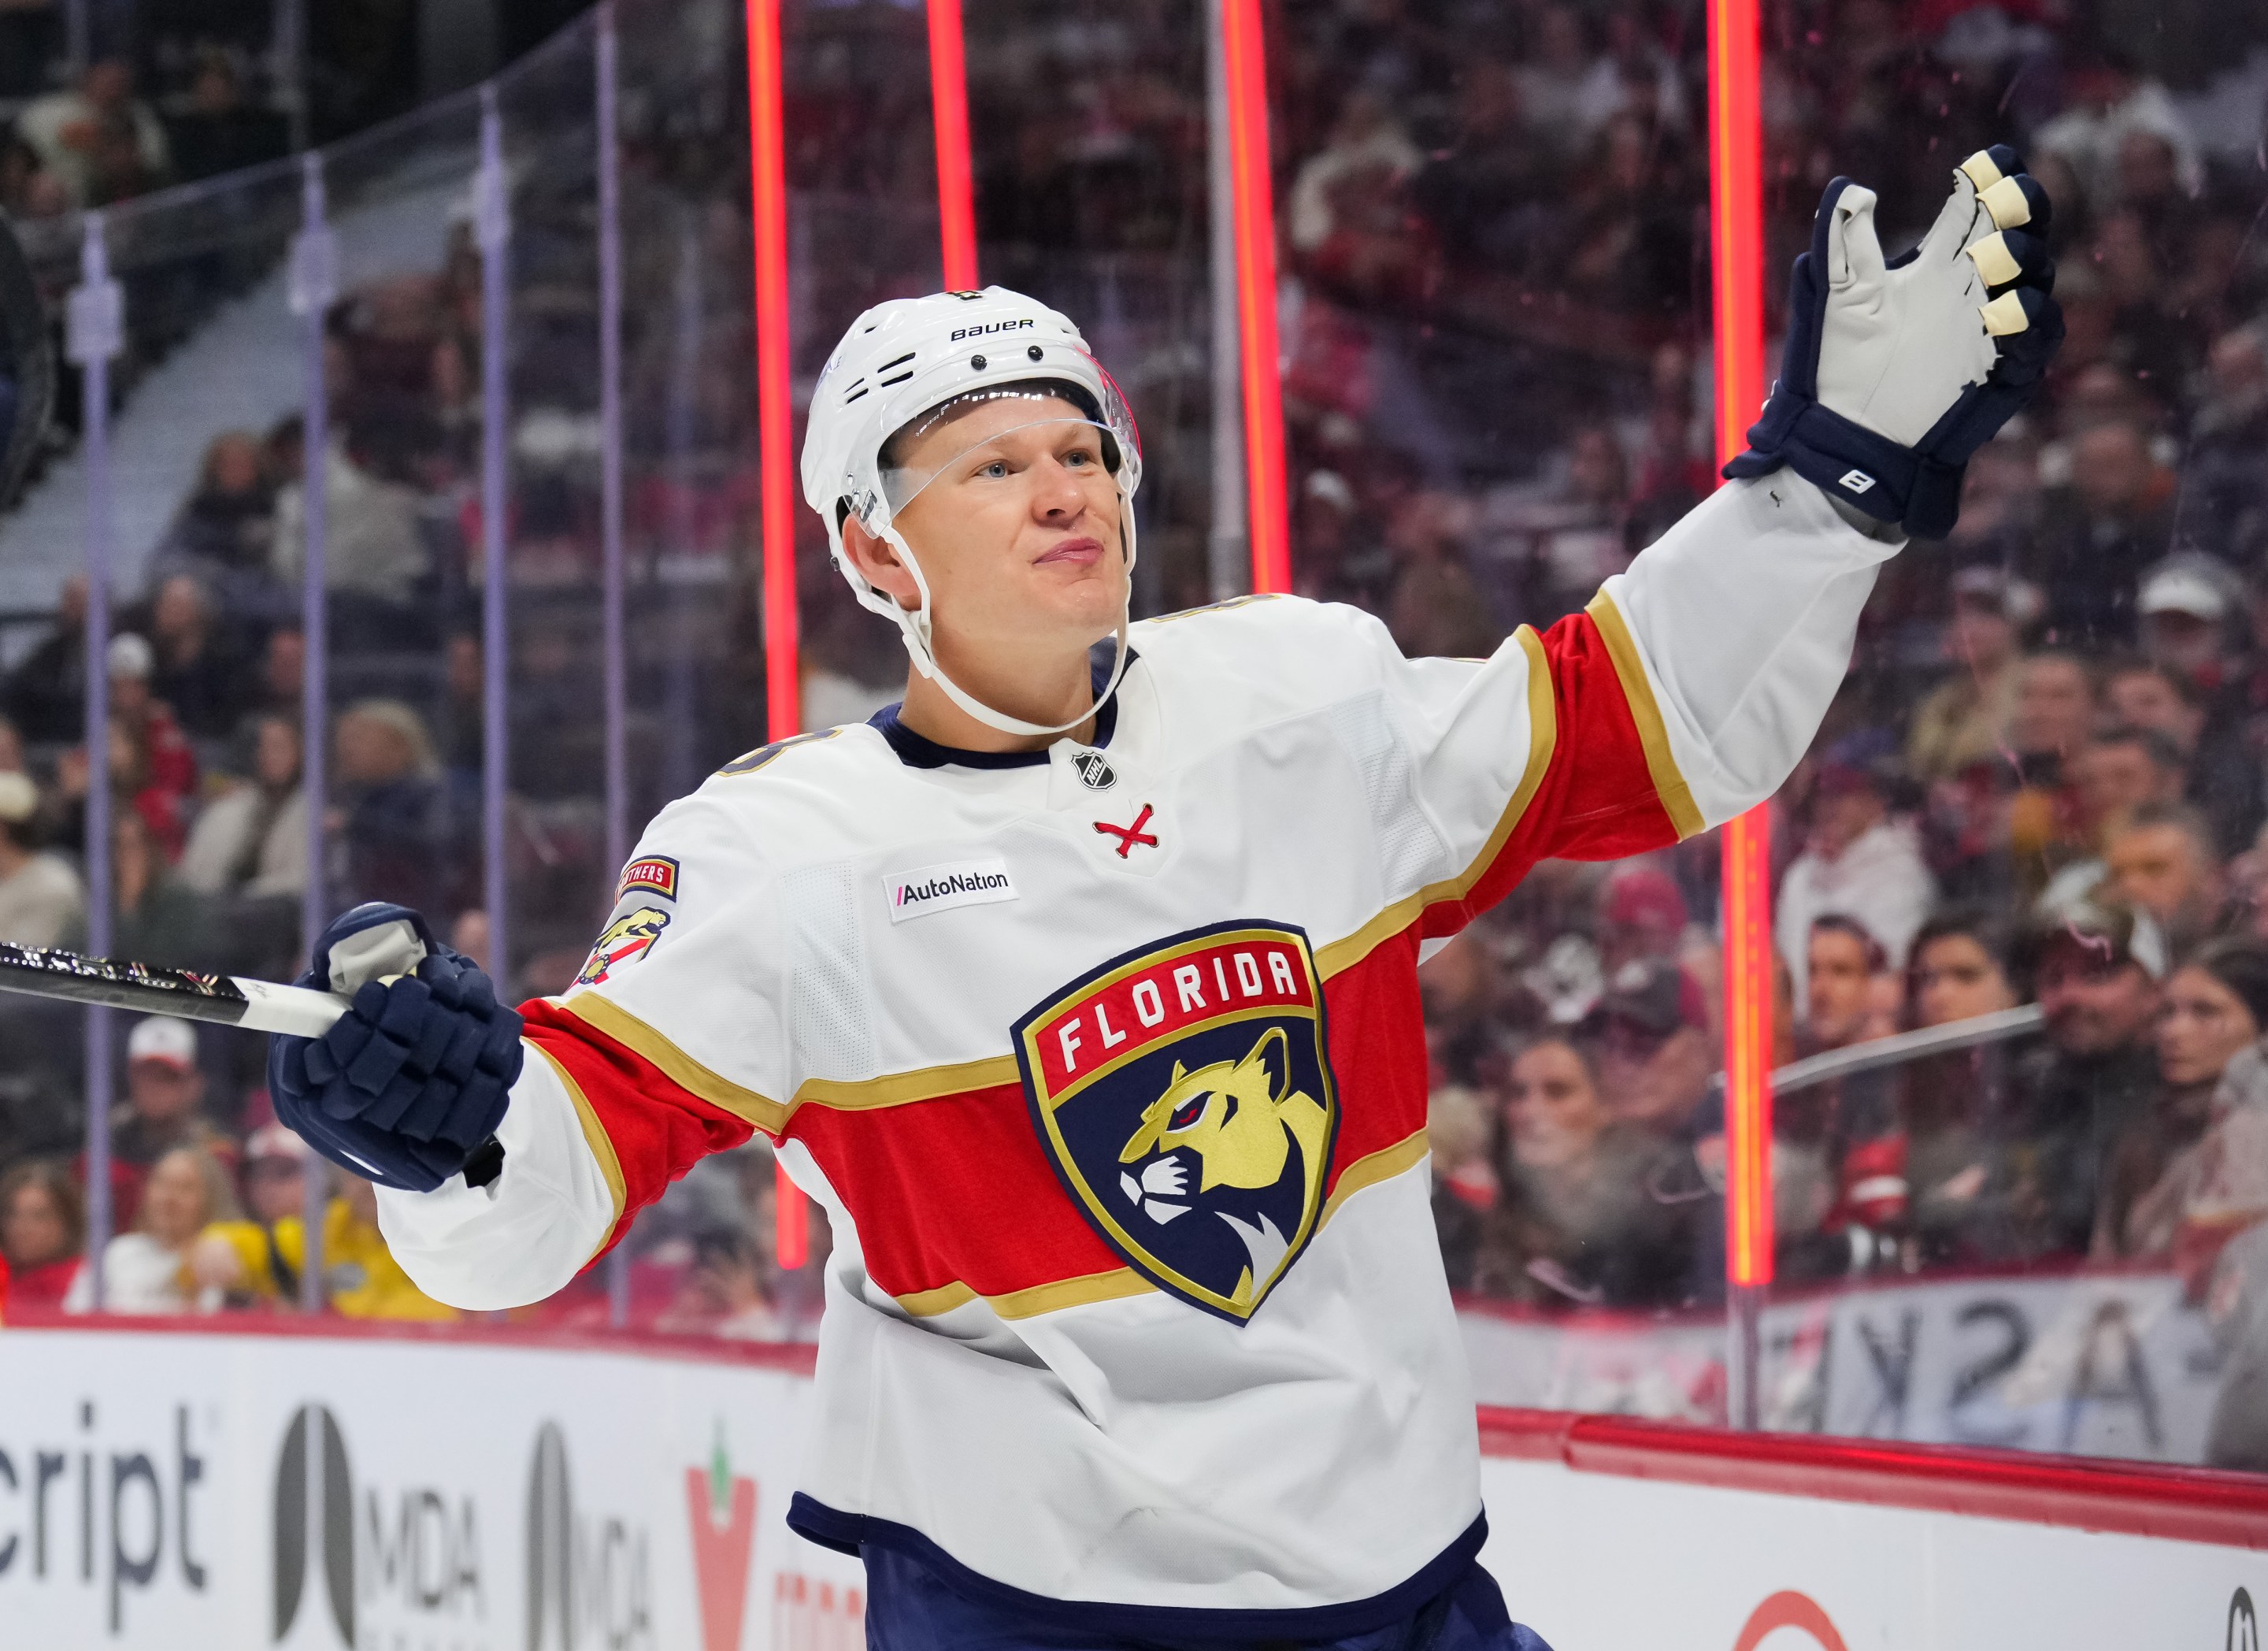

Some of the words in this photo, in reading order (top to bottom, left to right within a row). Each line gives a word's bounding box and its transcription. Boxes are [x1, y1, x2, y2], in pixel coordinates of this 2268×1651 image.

[951, 319, 1034, 341] BAUER
[1086, 759, 1103, 785] NHL
[1058, 952, 1298, 1073] FLORIDA
